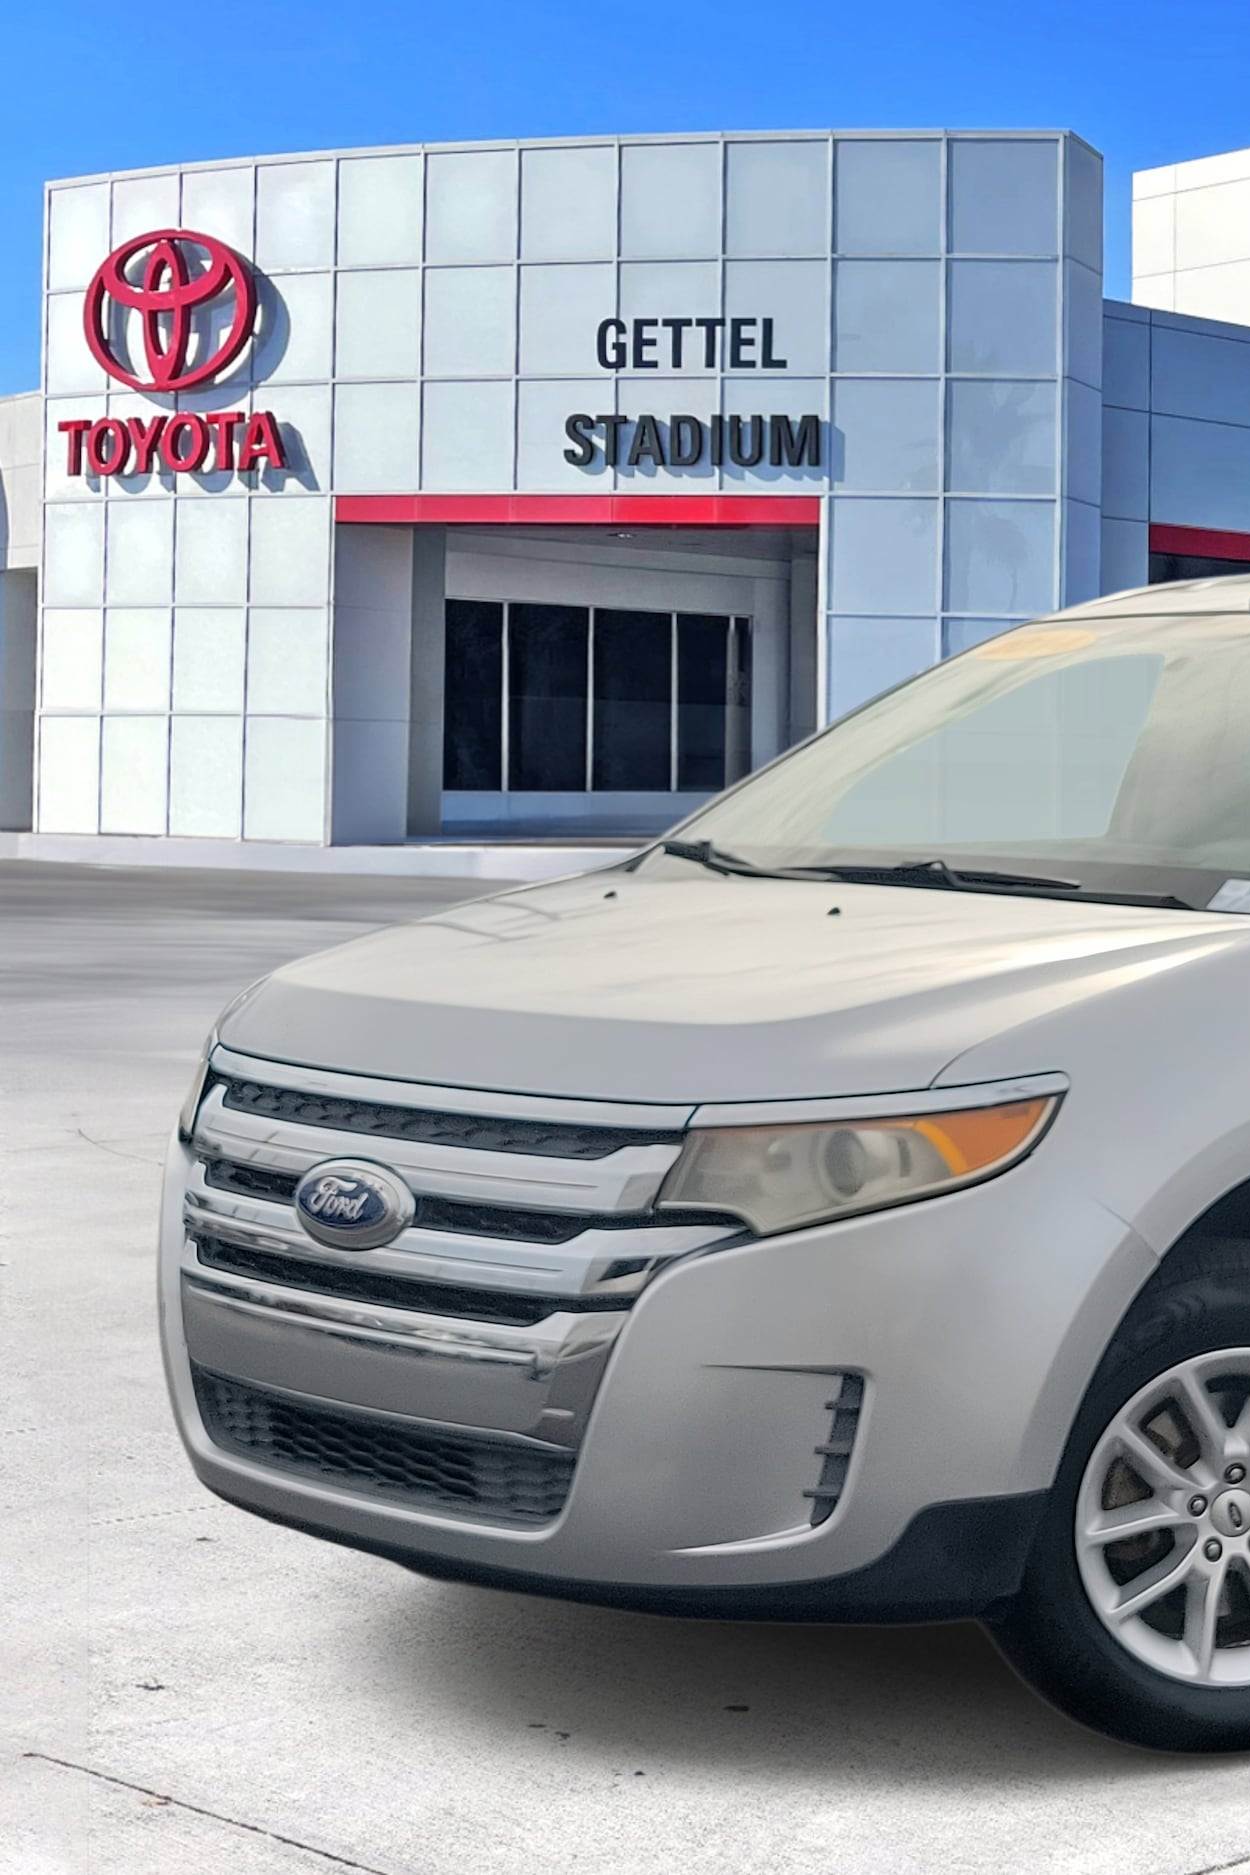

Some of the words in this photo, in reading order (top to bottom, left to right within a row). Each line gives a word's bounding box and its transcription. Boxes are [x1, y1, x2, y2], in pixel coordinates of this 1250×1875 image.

[597, 318, 787, 369] GETTEL
[58, 411, 288, 477] TOYOTA
[563, 413, 821, 467] STADIUM
[310, 1176, 369, 1220] Ford
